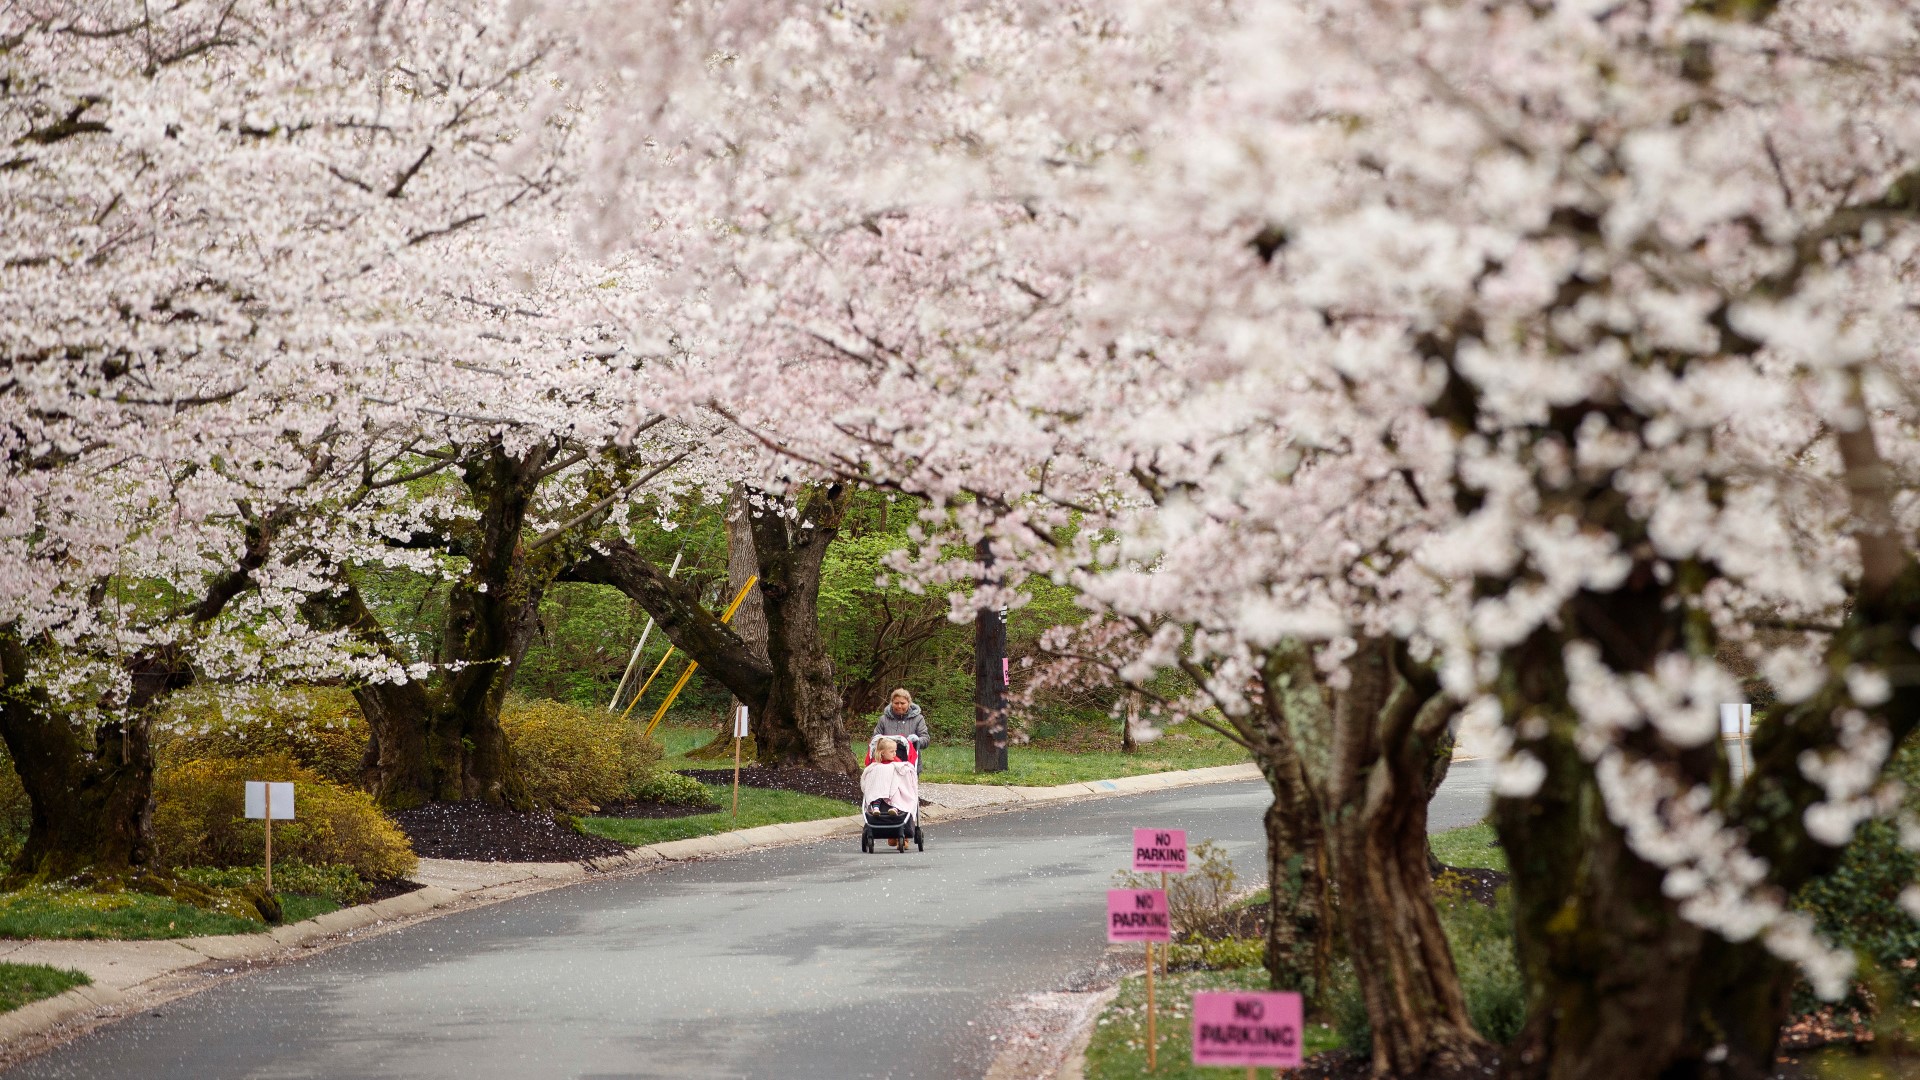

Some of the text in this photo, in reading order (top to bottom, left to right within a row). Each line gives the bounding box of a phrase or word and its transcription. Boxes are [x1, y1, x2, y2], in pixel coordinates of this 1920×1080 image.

[1155, 833, 1171, 846] NO
[1137, 848, 1185, 862] PARKING
[1136, 894, 1154, 909] NO
[1113, 912, 1168, 928] PARKING
[1234, 1000, 1264, 1021] NO
[1200, 1025, 1295, 1046] PARKING
